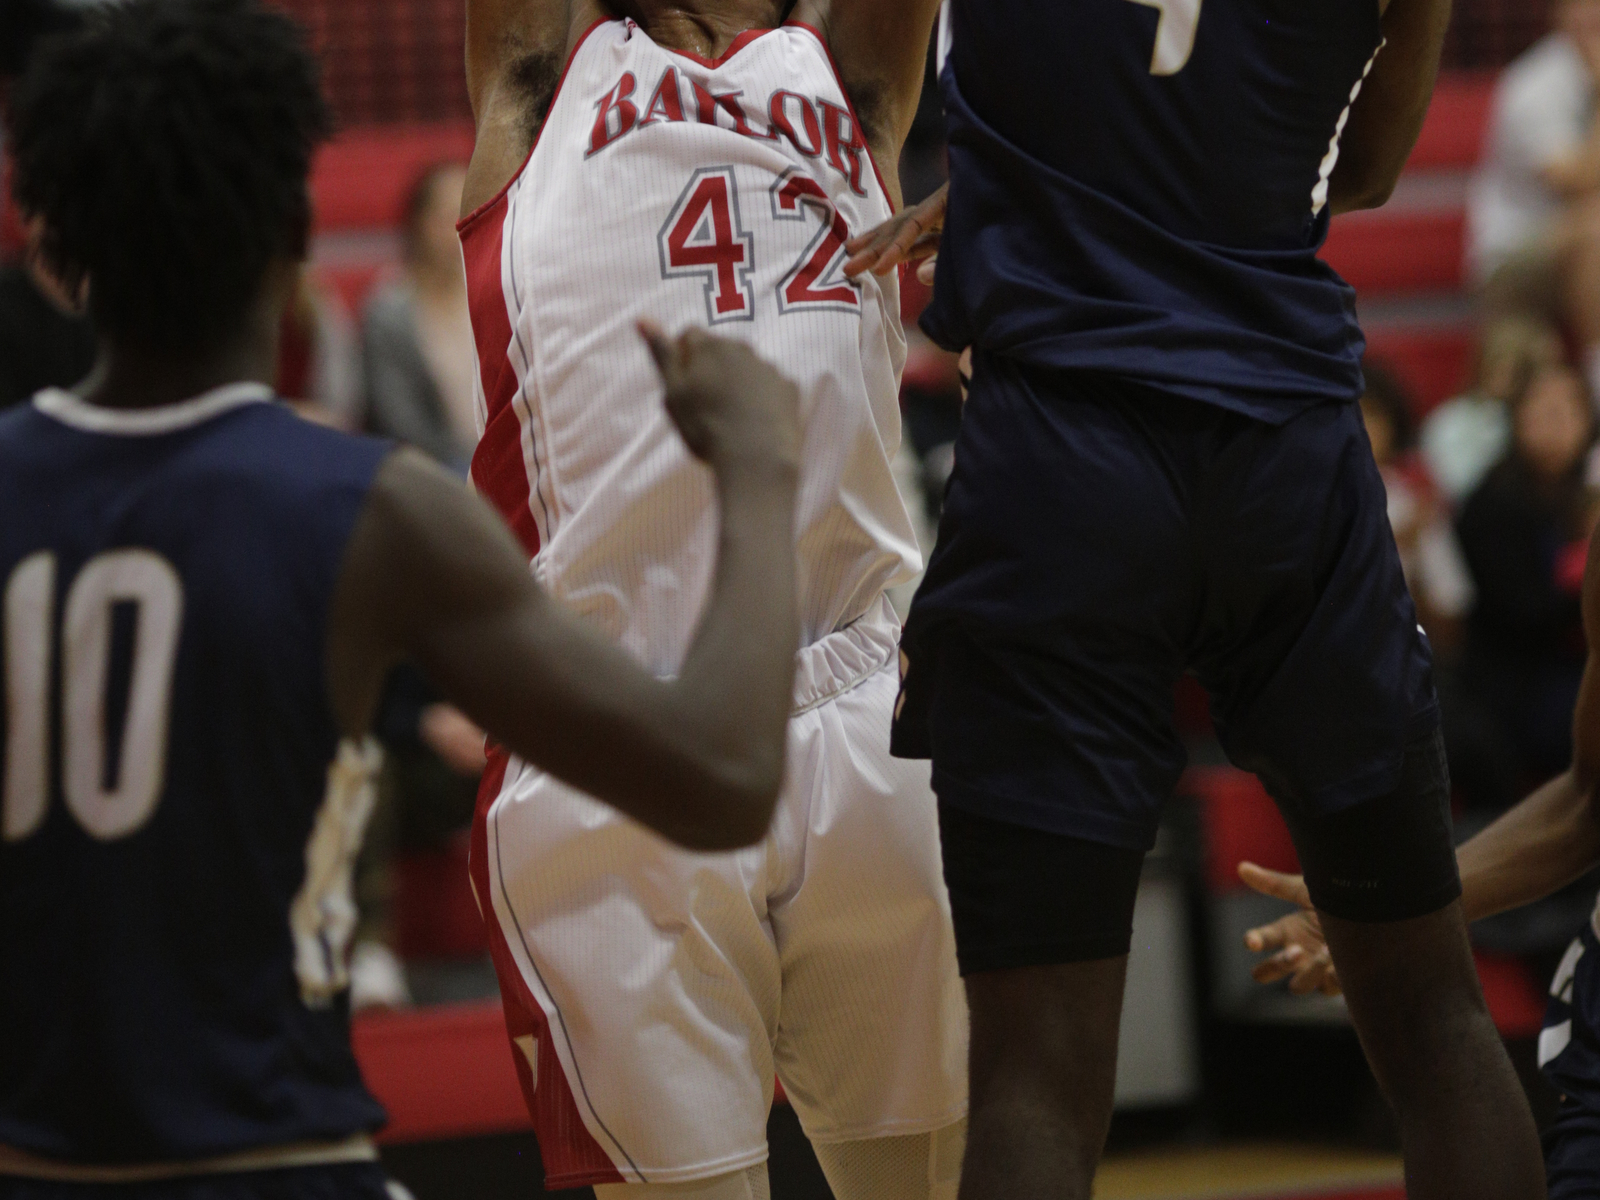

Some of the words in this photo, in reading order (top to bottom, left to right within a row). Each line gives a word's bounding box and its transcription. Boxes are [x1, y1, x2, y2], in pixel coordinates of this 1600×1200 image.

[584, 65, 868, 198] BAYLOR
[657, 165, 862, 326] 42
[2, 547, 184, 842] 10
